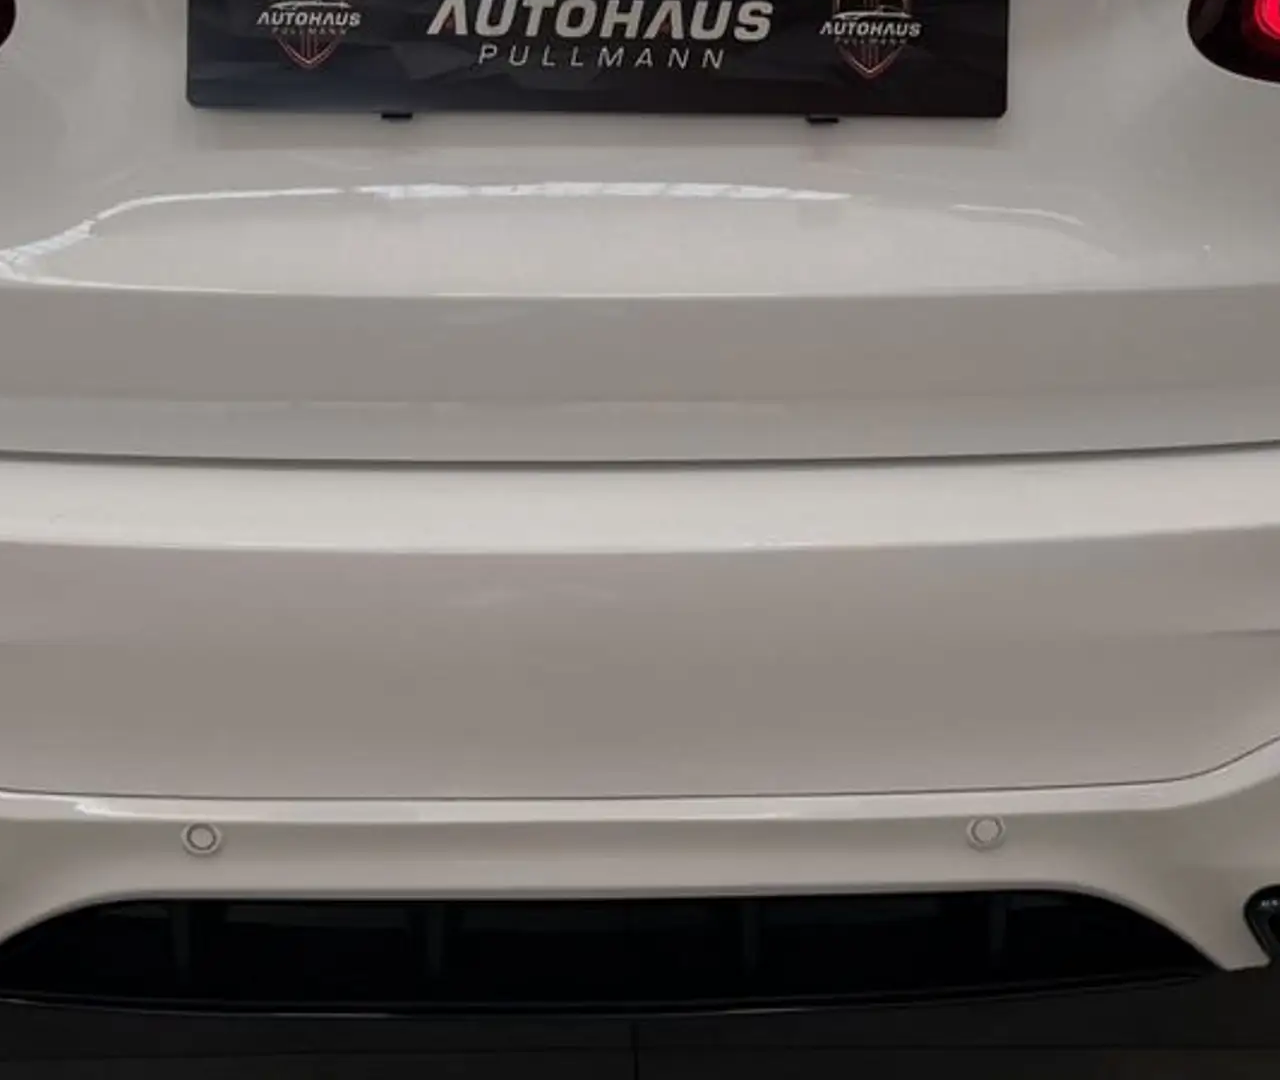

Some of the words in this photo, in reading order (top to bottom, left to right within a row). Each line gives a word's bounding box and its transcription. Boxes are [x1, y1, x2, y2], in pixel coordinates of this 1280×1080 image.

[256, 11, 361, 27] AUTOHAUS
[819, 21, 922, 37] AUTOHAUS
[478, 45, 724, 69] PULLMANN
